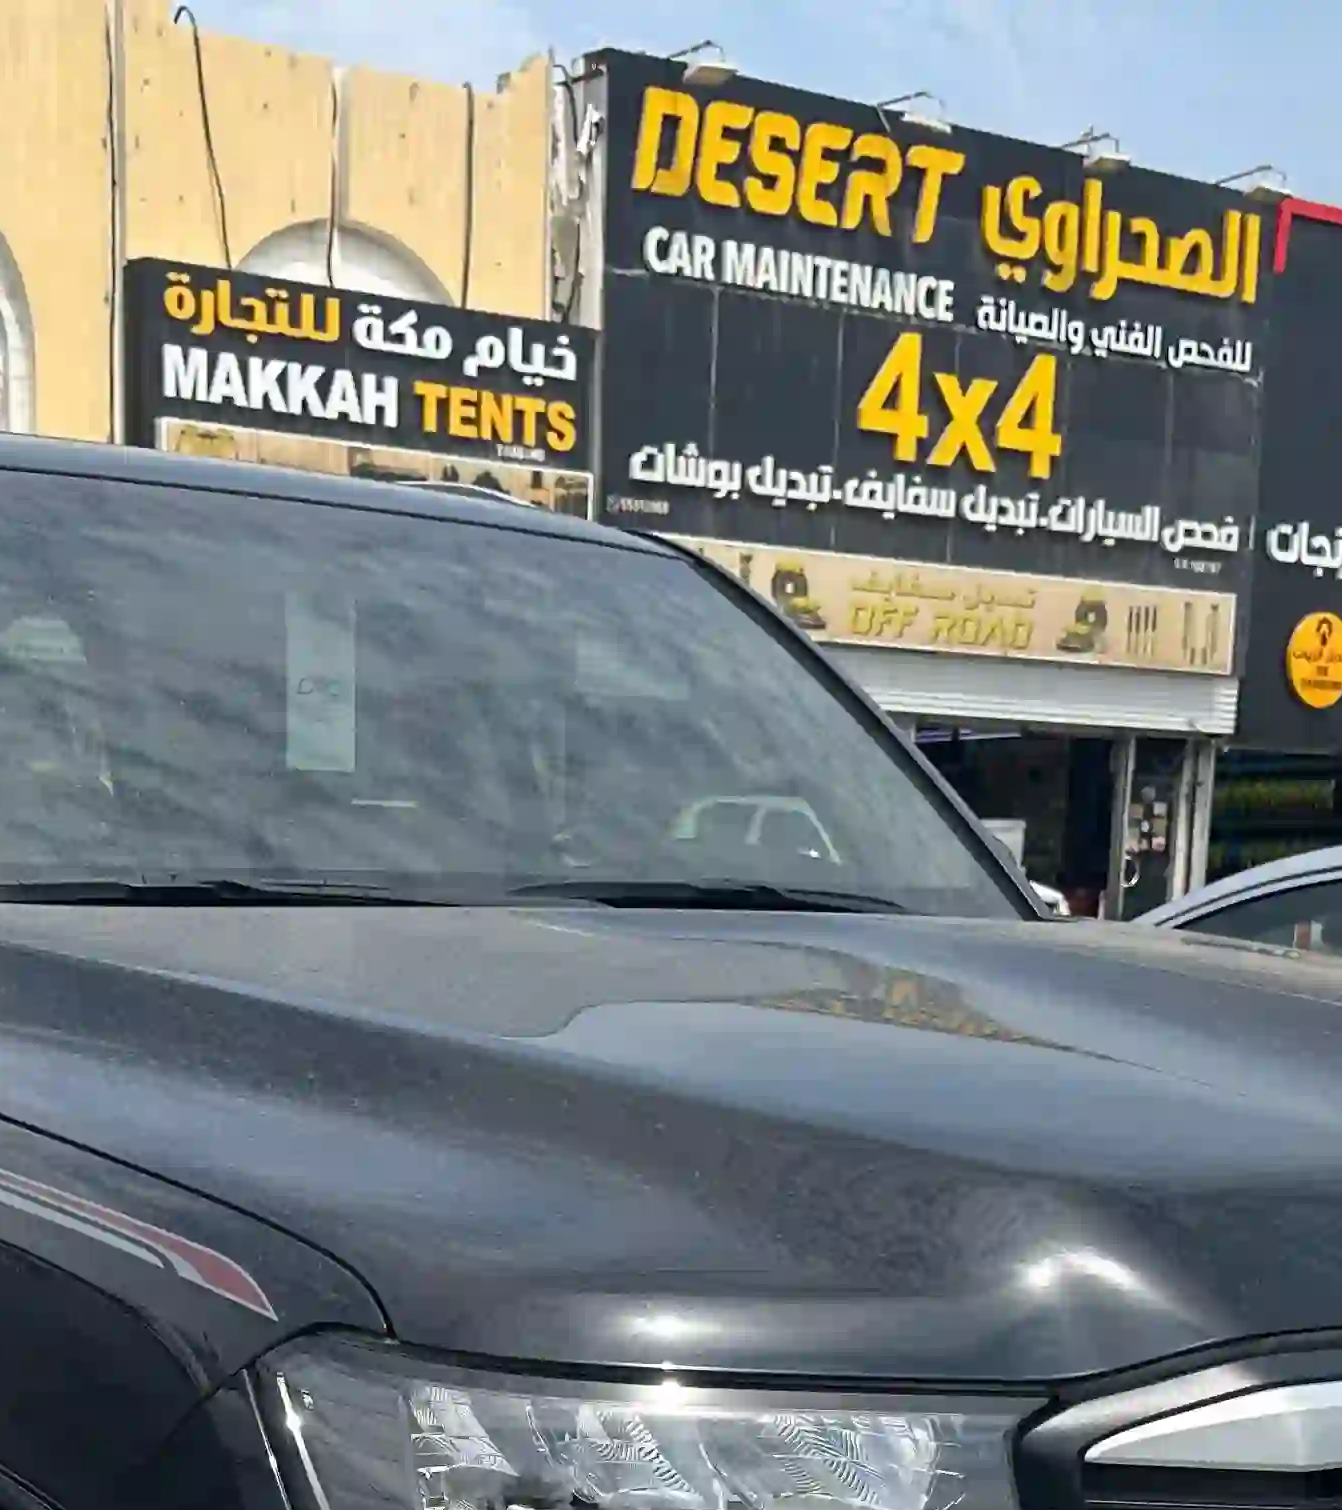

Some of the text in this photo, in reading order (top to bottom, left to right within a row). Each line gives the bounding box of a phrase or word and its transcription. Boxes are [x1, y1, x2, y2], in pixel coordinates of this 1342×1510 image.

[632, 86, 965, 243] DESERT
[643, 226, 955, 324] CAR MAINTENANCE
[979, 175, 1261, 304] الصحراوي
[163, 272, 578, 388] خيام مكة للتجارة
[976, 294, 1253, 375] للفحص الفني والصيانة
[161, 343, 576, 453] MAKKAH TENTS
[856, 332, 1063, 481] 4x4
[1162, 516, 1240, 553] فحص
[850, 603, 1034, 650] OFF ROAD
